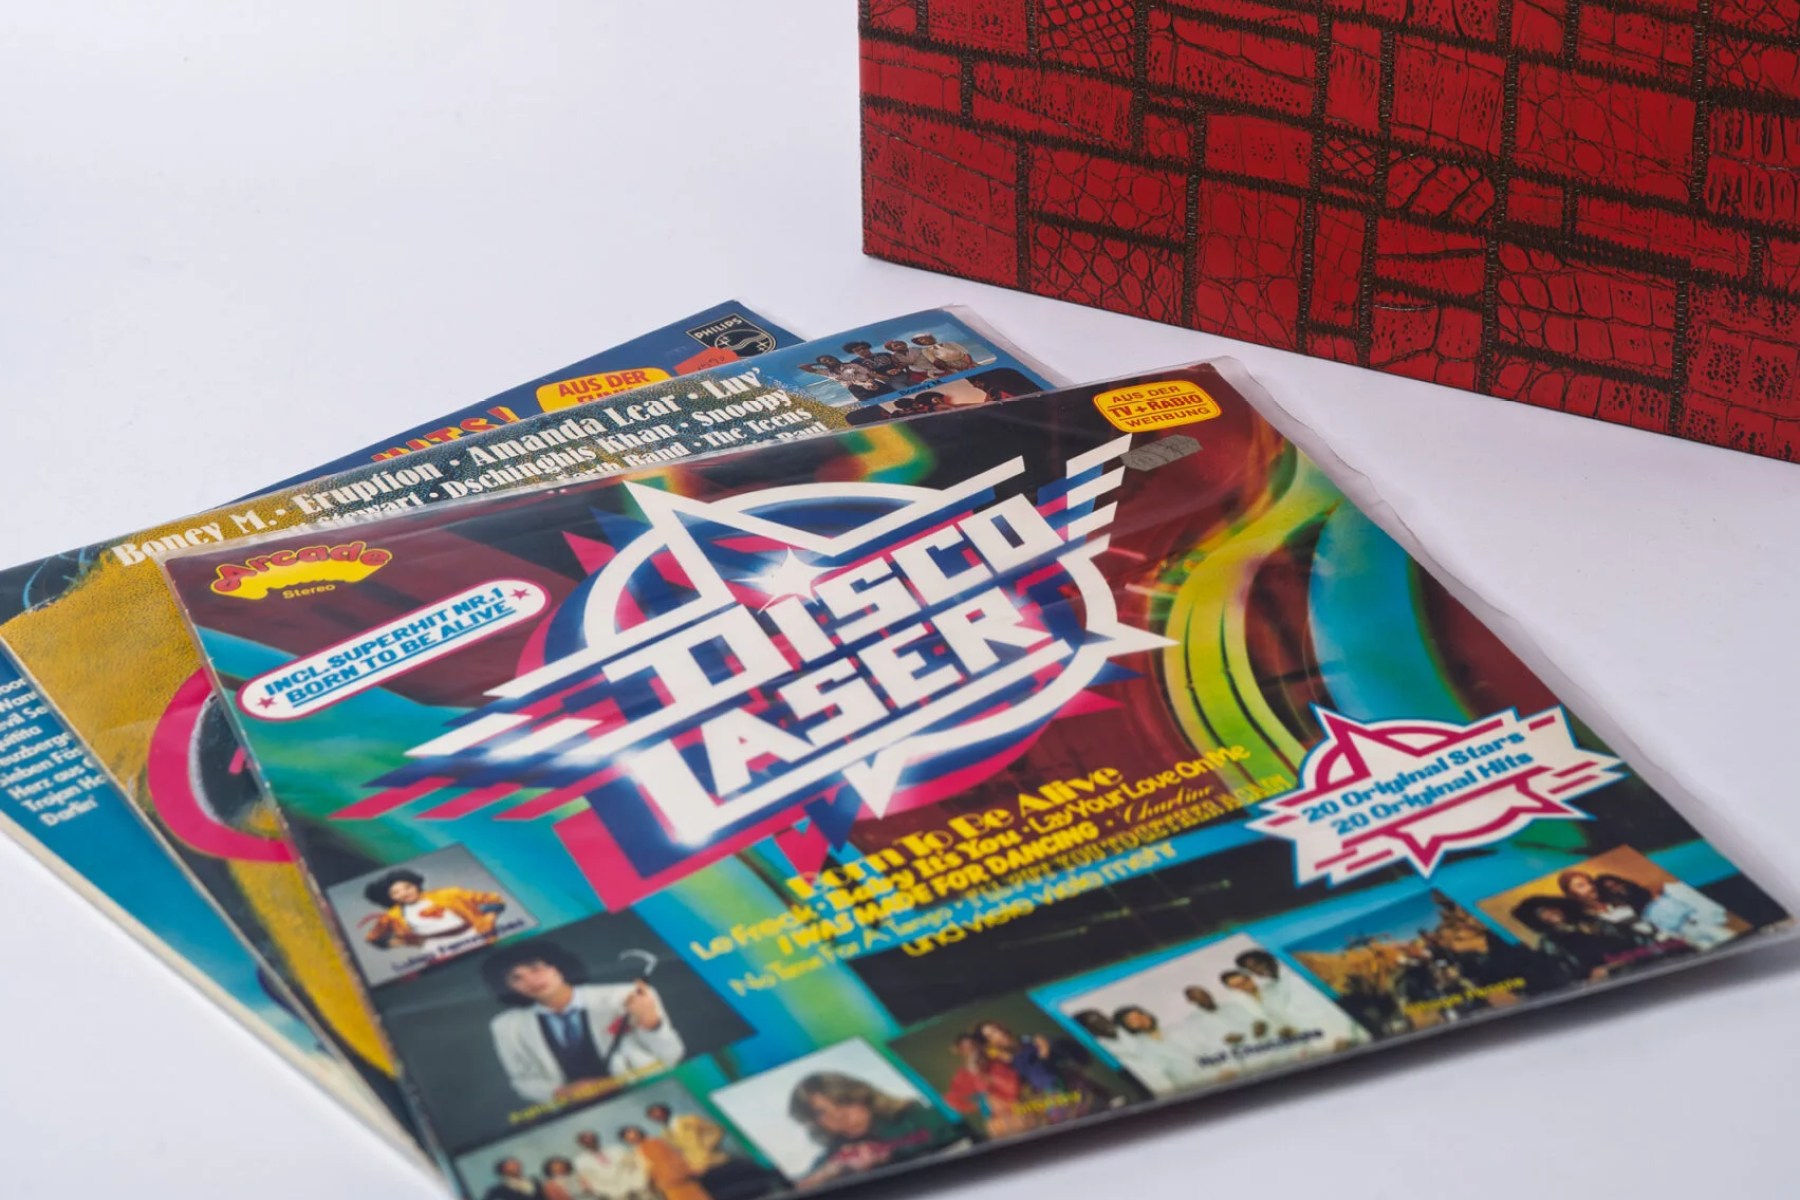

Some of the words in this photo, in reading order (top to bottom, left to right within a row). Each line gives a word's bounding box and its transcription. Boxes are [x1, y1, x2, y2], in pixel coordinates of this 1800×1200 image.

[694, 317, 742, 339] PHILIPS
[558, 378, 602, 397] AUS
[604, 370, 651, 388] DER
[1108, 403, 1133, 418] TV
[1148, 394, 1204, 411] RADIO
[1112, 392, 1144, 403] AUS
[1147, 385, 1181, 397] DER
[1126, 407, 1210, 427] WERBUNG
[439, 443, 597, 500] Dschinghis
[595, 421, 678, 455] Khan
[691, 388, 793, 428] Snoopy
[623, 441, 691, 468] Band
[699, 424, 748, 449] The
[743, 407, 812, 435] Teens
[111, 522, 224, 567] Boney
[229, 510, 278, 534] M.
[291, 462, 444, 514] Eruption
[466, 416, 607, 467] Amanda
[603, 394, 682, 428] Lear
[213, 542, 390, 592] Arcade
[282, 584, 336, 599] Stereo
[454, 587, 505, 614] NR.1
[286, 667, 361, 705] BORN
[360, 650, 397, 674] TO
[400, 633, 438, 657] BE
[441, 600, 514, 640] ALIVE
[625, 586, 1060, 847] LASER
[891, 830, 953, 856] To
[948, 808, 1014, 840] Be
[1018, 767, 1123, 817] Alive
[1302, 801, 1340, 823] 20
[1340, 757, 1450, 806] Original
[1447, 732, 1526, 766] Stars
[1331, 813, 1368, 835] 20
[1369, 771, 1479, 821] Original
[1477, 751, 1534, 779] Hits
[690, 936, 733, 960] Le
[825, 870, 915, 910] Baby
[955, 828, 1022, 860] You
[777, 935, 793, 955] I
[790, 913, 854, 947] WAS
[853, 883, 934, 925] MADE
[930, 862, 990, 896] FOR
[984, 821, 1099, 876] DANCING
[901, 922, 967, 957] und
[1101, 840, 1177, 880] mehr
